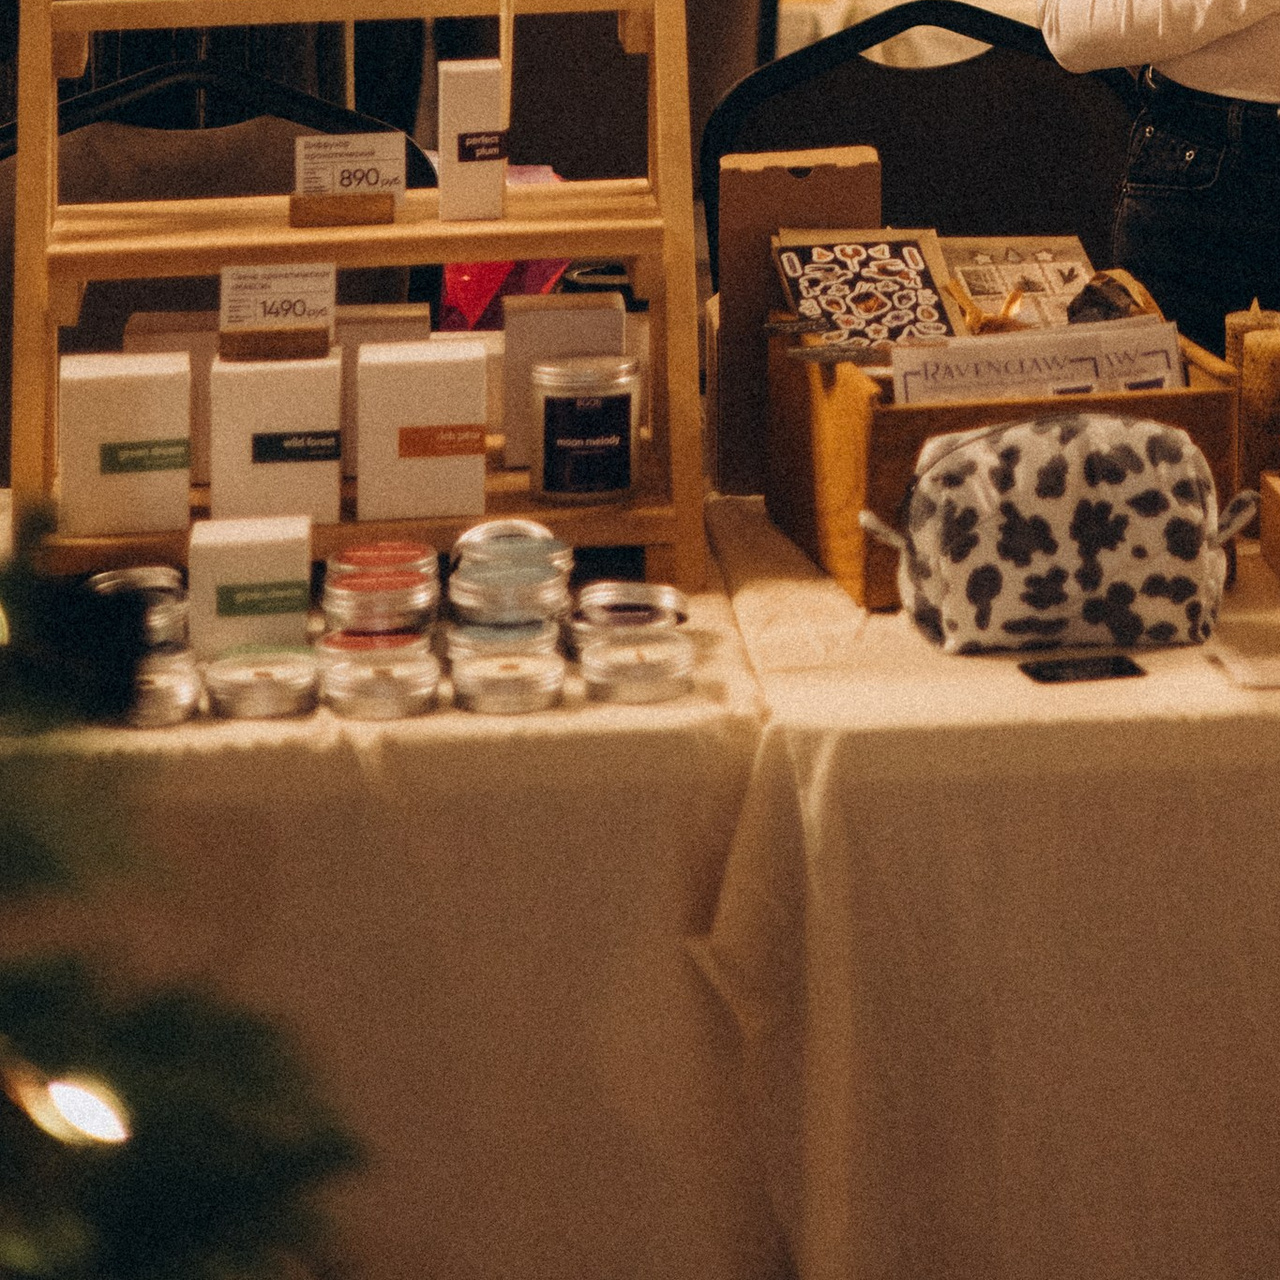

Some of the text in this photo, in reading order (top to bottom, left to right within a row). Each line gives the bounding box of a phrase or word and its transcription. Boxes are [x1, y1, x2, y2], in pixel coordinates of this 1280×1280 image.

[340, 167, 380, 188] 890
[260, 299, 306, 318] 1490
[923, 353, 1070, 381] RAVENCLAW
[556, 435, 621, 448] moon melody
